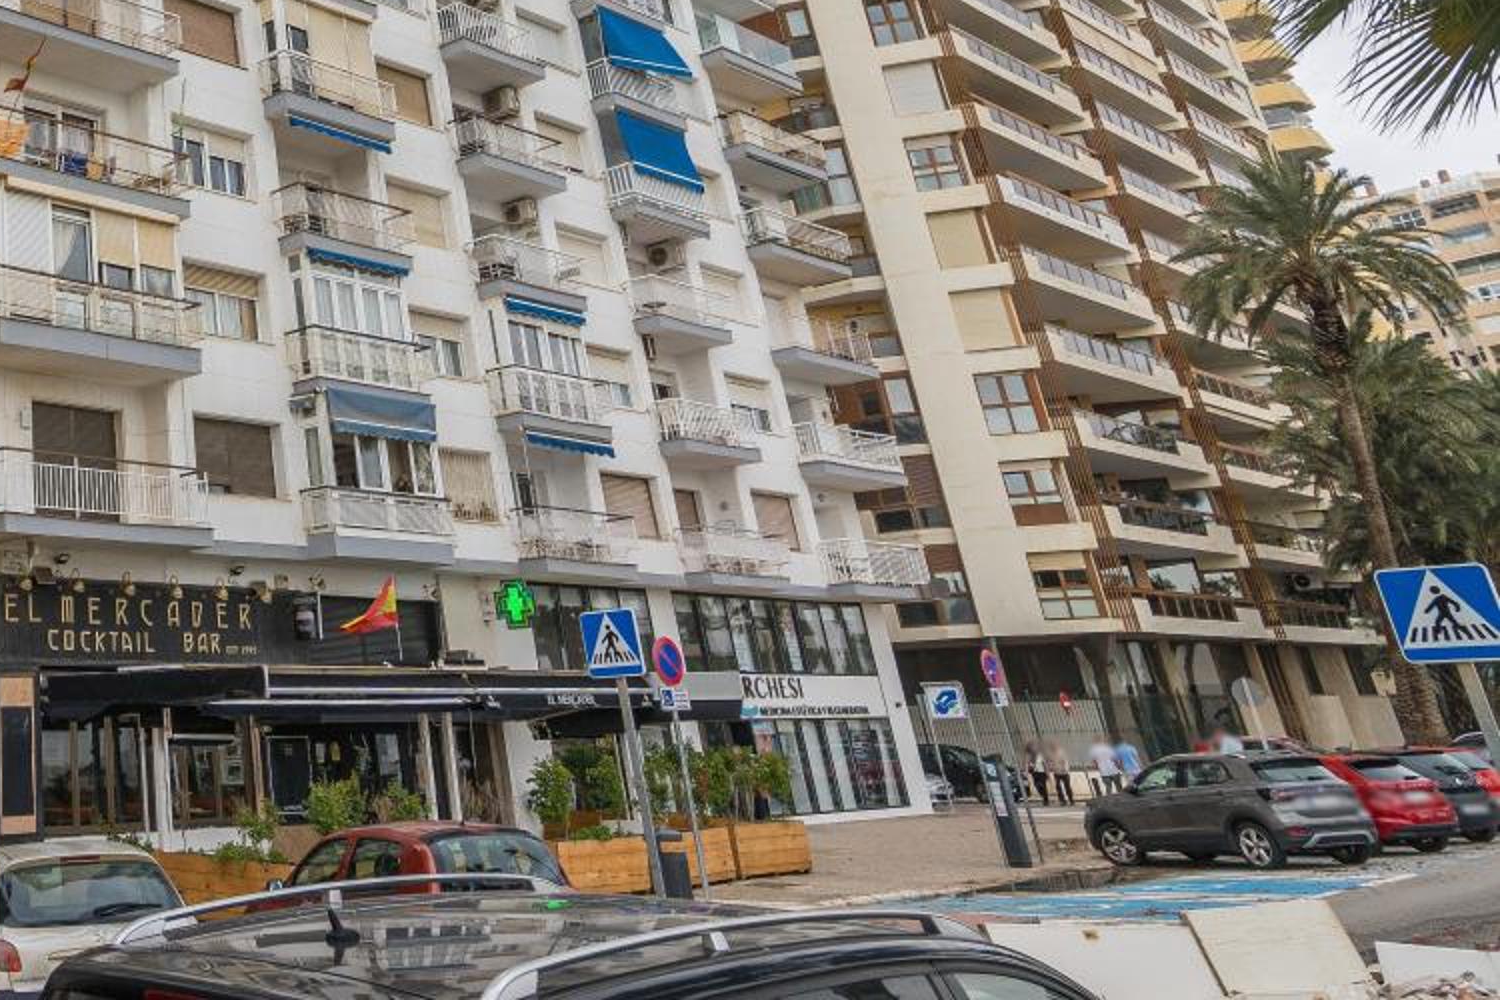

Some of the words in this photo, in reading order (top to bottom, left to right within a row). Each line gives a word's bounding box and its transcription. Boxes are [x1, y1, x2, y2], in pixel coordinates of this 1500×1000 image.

[4, 593, 42, 623] EL
[61, 595, 251, 630] MERCADER
[47, 629, 156, 653] COCKTAIL
[183, 632, 221, 654] BAR
